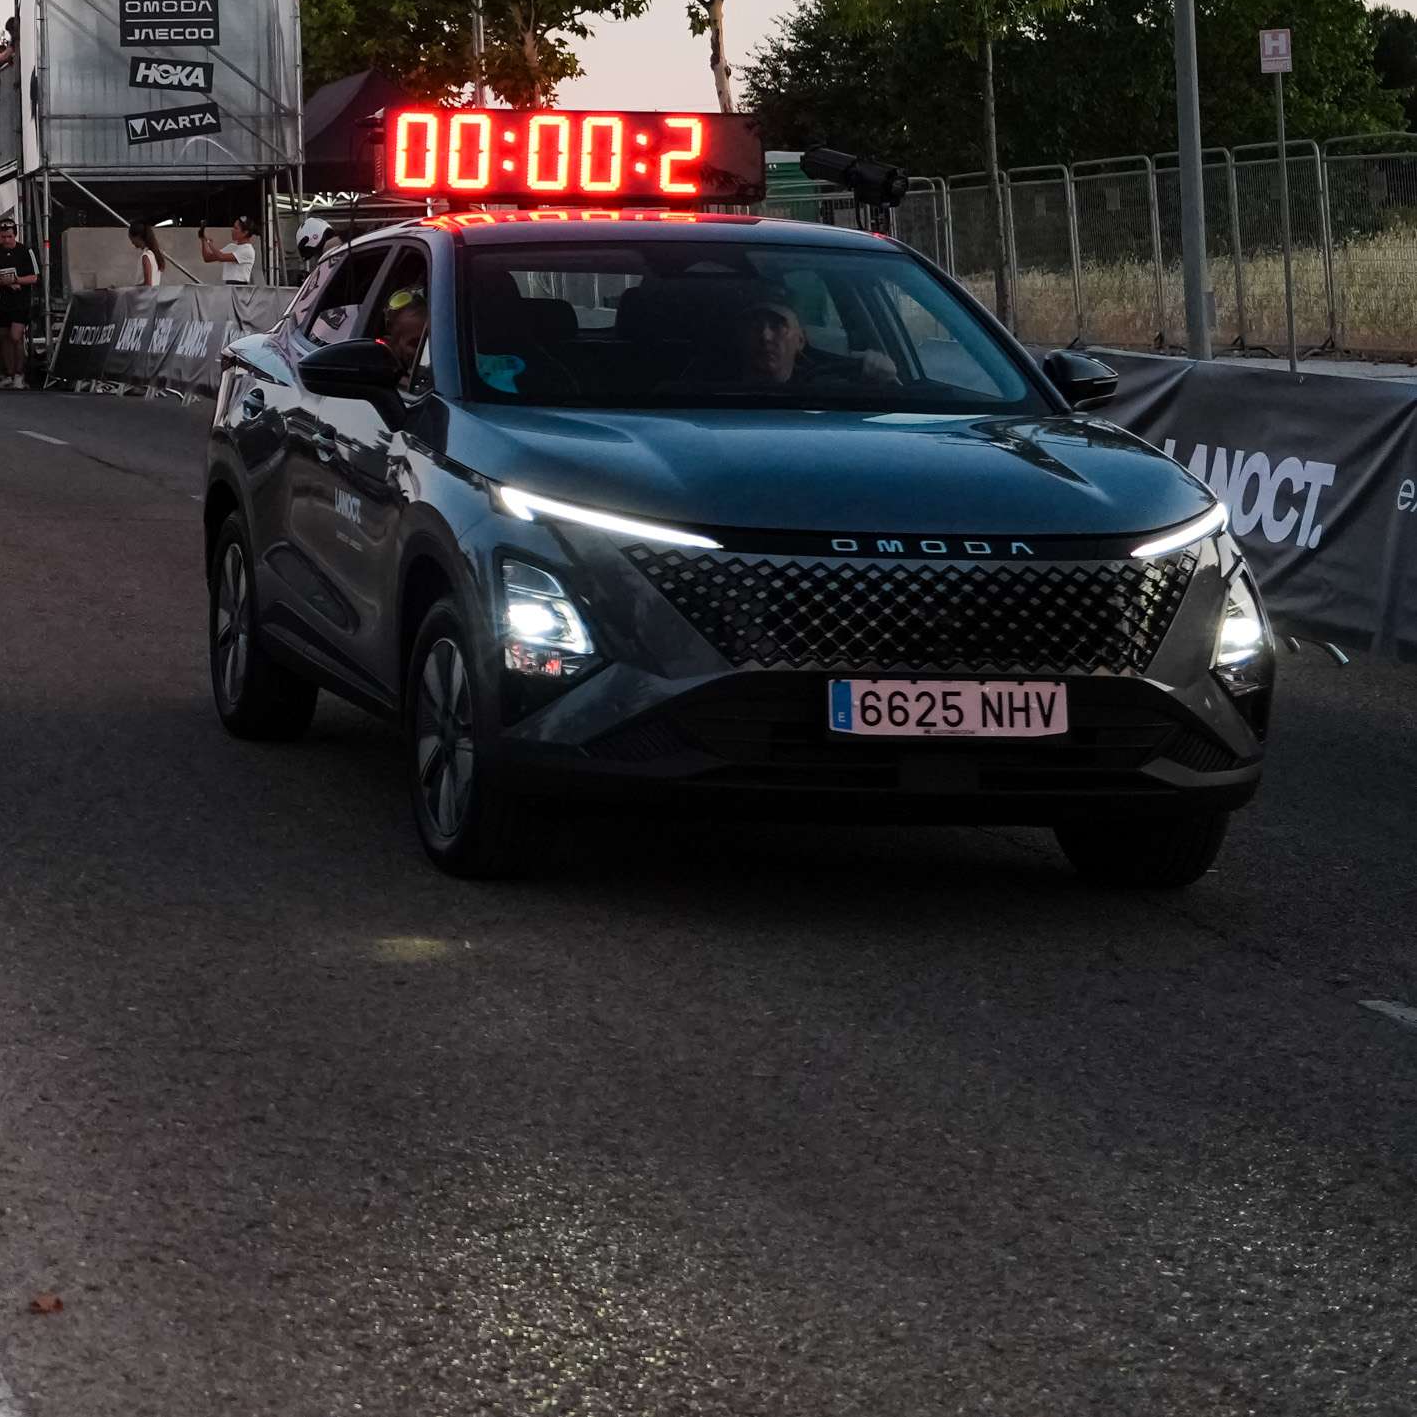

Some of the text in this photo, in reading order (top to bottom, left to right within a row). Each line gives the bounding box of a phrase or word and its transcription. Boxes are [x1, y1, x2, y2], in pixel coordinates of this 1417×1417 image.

[125, 0, 213, 13] OMODA
[126, 27, 215, 40] JAECOO
[1264, 33, 1286, 56] H
[135, 62, 206, 88] HOKA
[150, 112, 217, 132] VARTA
[1163, 438, 1337, 550] NOCT.
[830, 538, 1035, 556] OMODA
[837, 690, 1057, 729] E 6625 NHV
